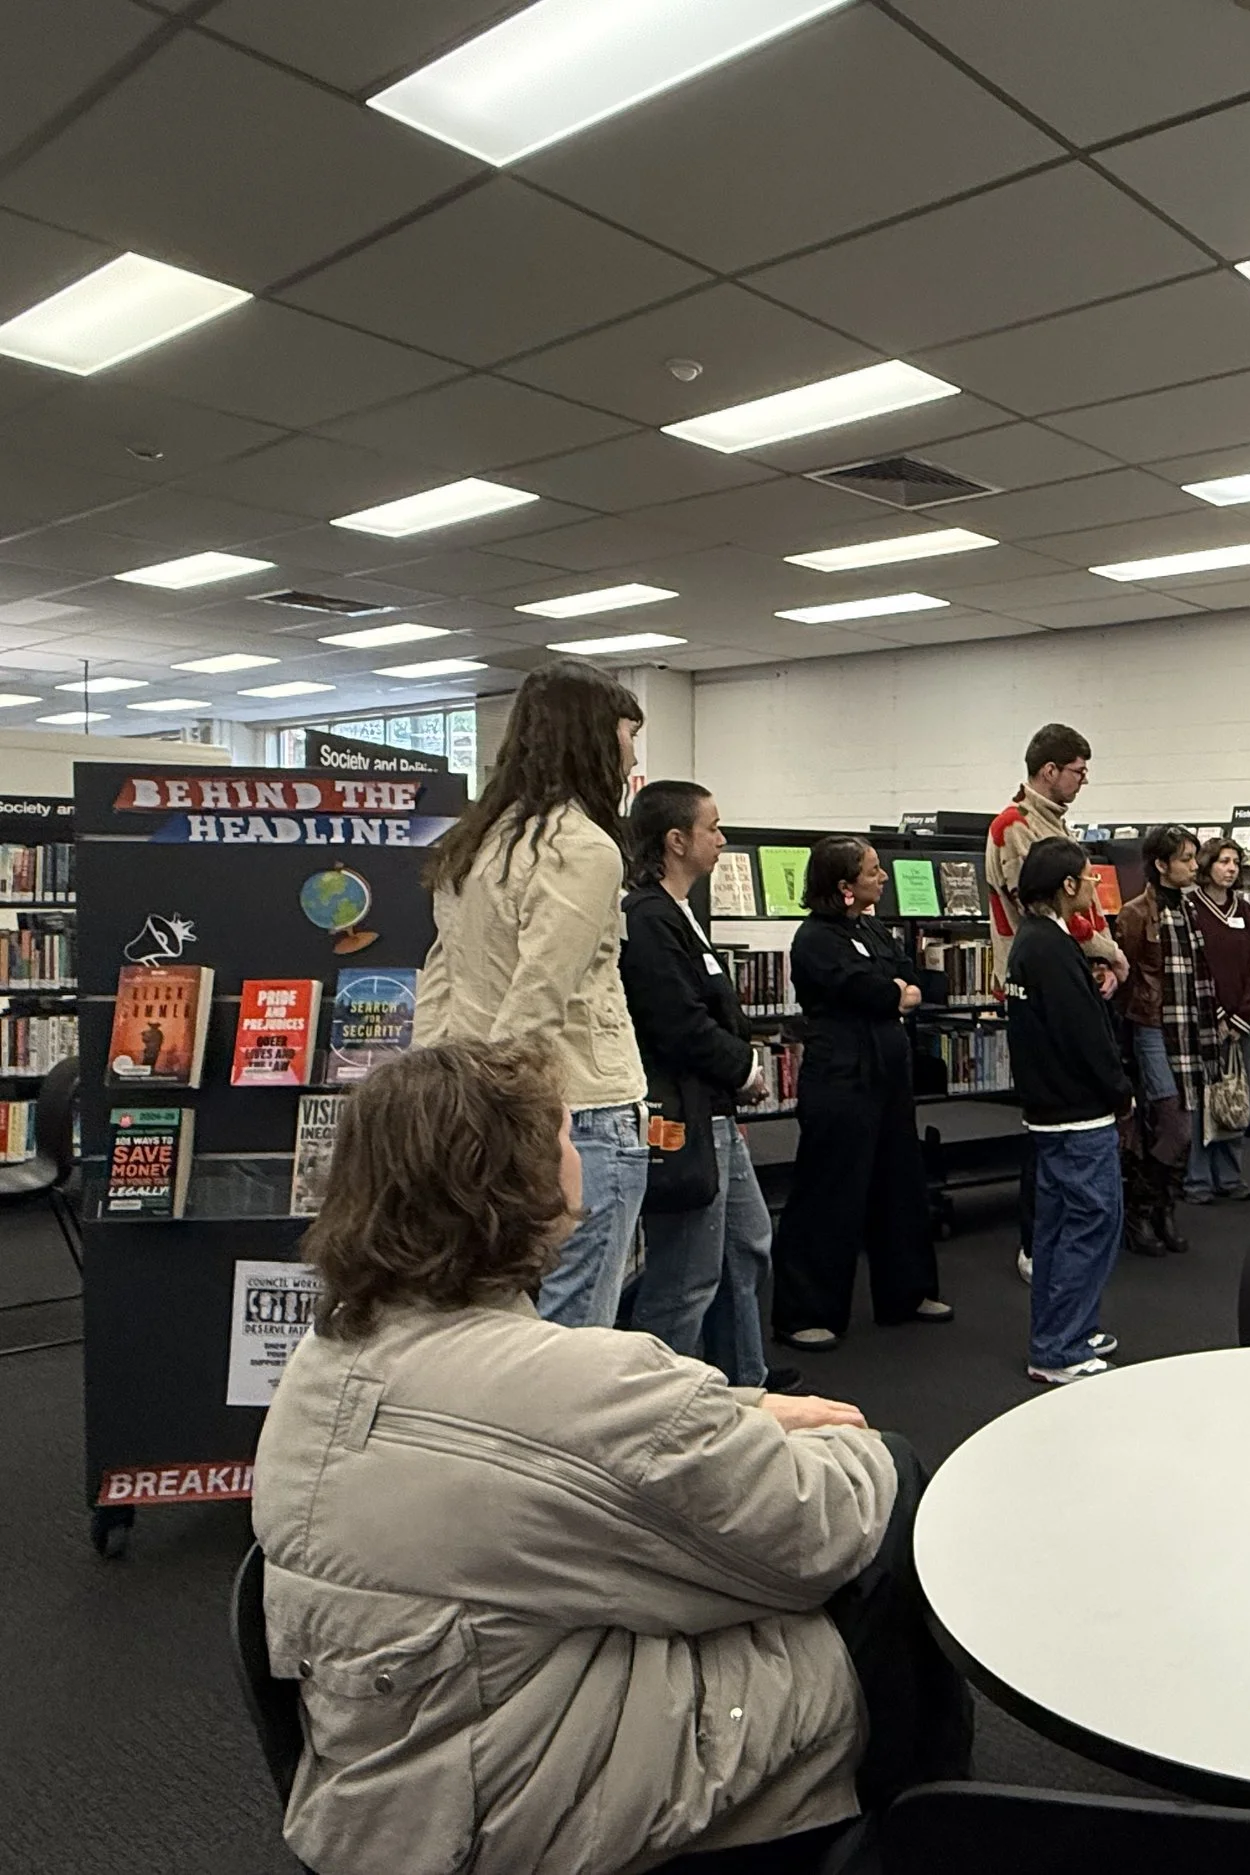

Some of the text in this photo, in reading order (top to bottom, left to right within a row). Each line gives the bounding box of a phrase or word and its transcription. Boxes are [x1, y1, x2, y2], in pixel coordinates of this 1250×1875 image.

[320, 744, 370, 771] Society
[374, 757, 397, 771] and
[132, 778, 416, 811] BEHIND THE
[57, 805, 76, 816] an
[188, 815, 411, 846] HEADLINE
[256, 989, 299, 1007] PRIDE
[349, 1000, 398, 1014] SEARCH
[342, 1024, 403, 1038] SECURITY
[133, 1136, 160, 1146] WAYS
[161, 1136, 174, 1145] TO
[113, 1145, 173, 1164] SAVE
[111, 1164, 171, 1177] MONEY
[108, 1186, 171, 1197] LEGALLY!
[247, 1277, 321, 1289] COUNCIL WORK
[244, 1323, 286, 1335] DESERVE
